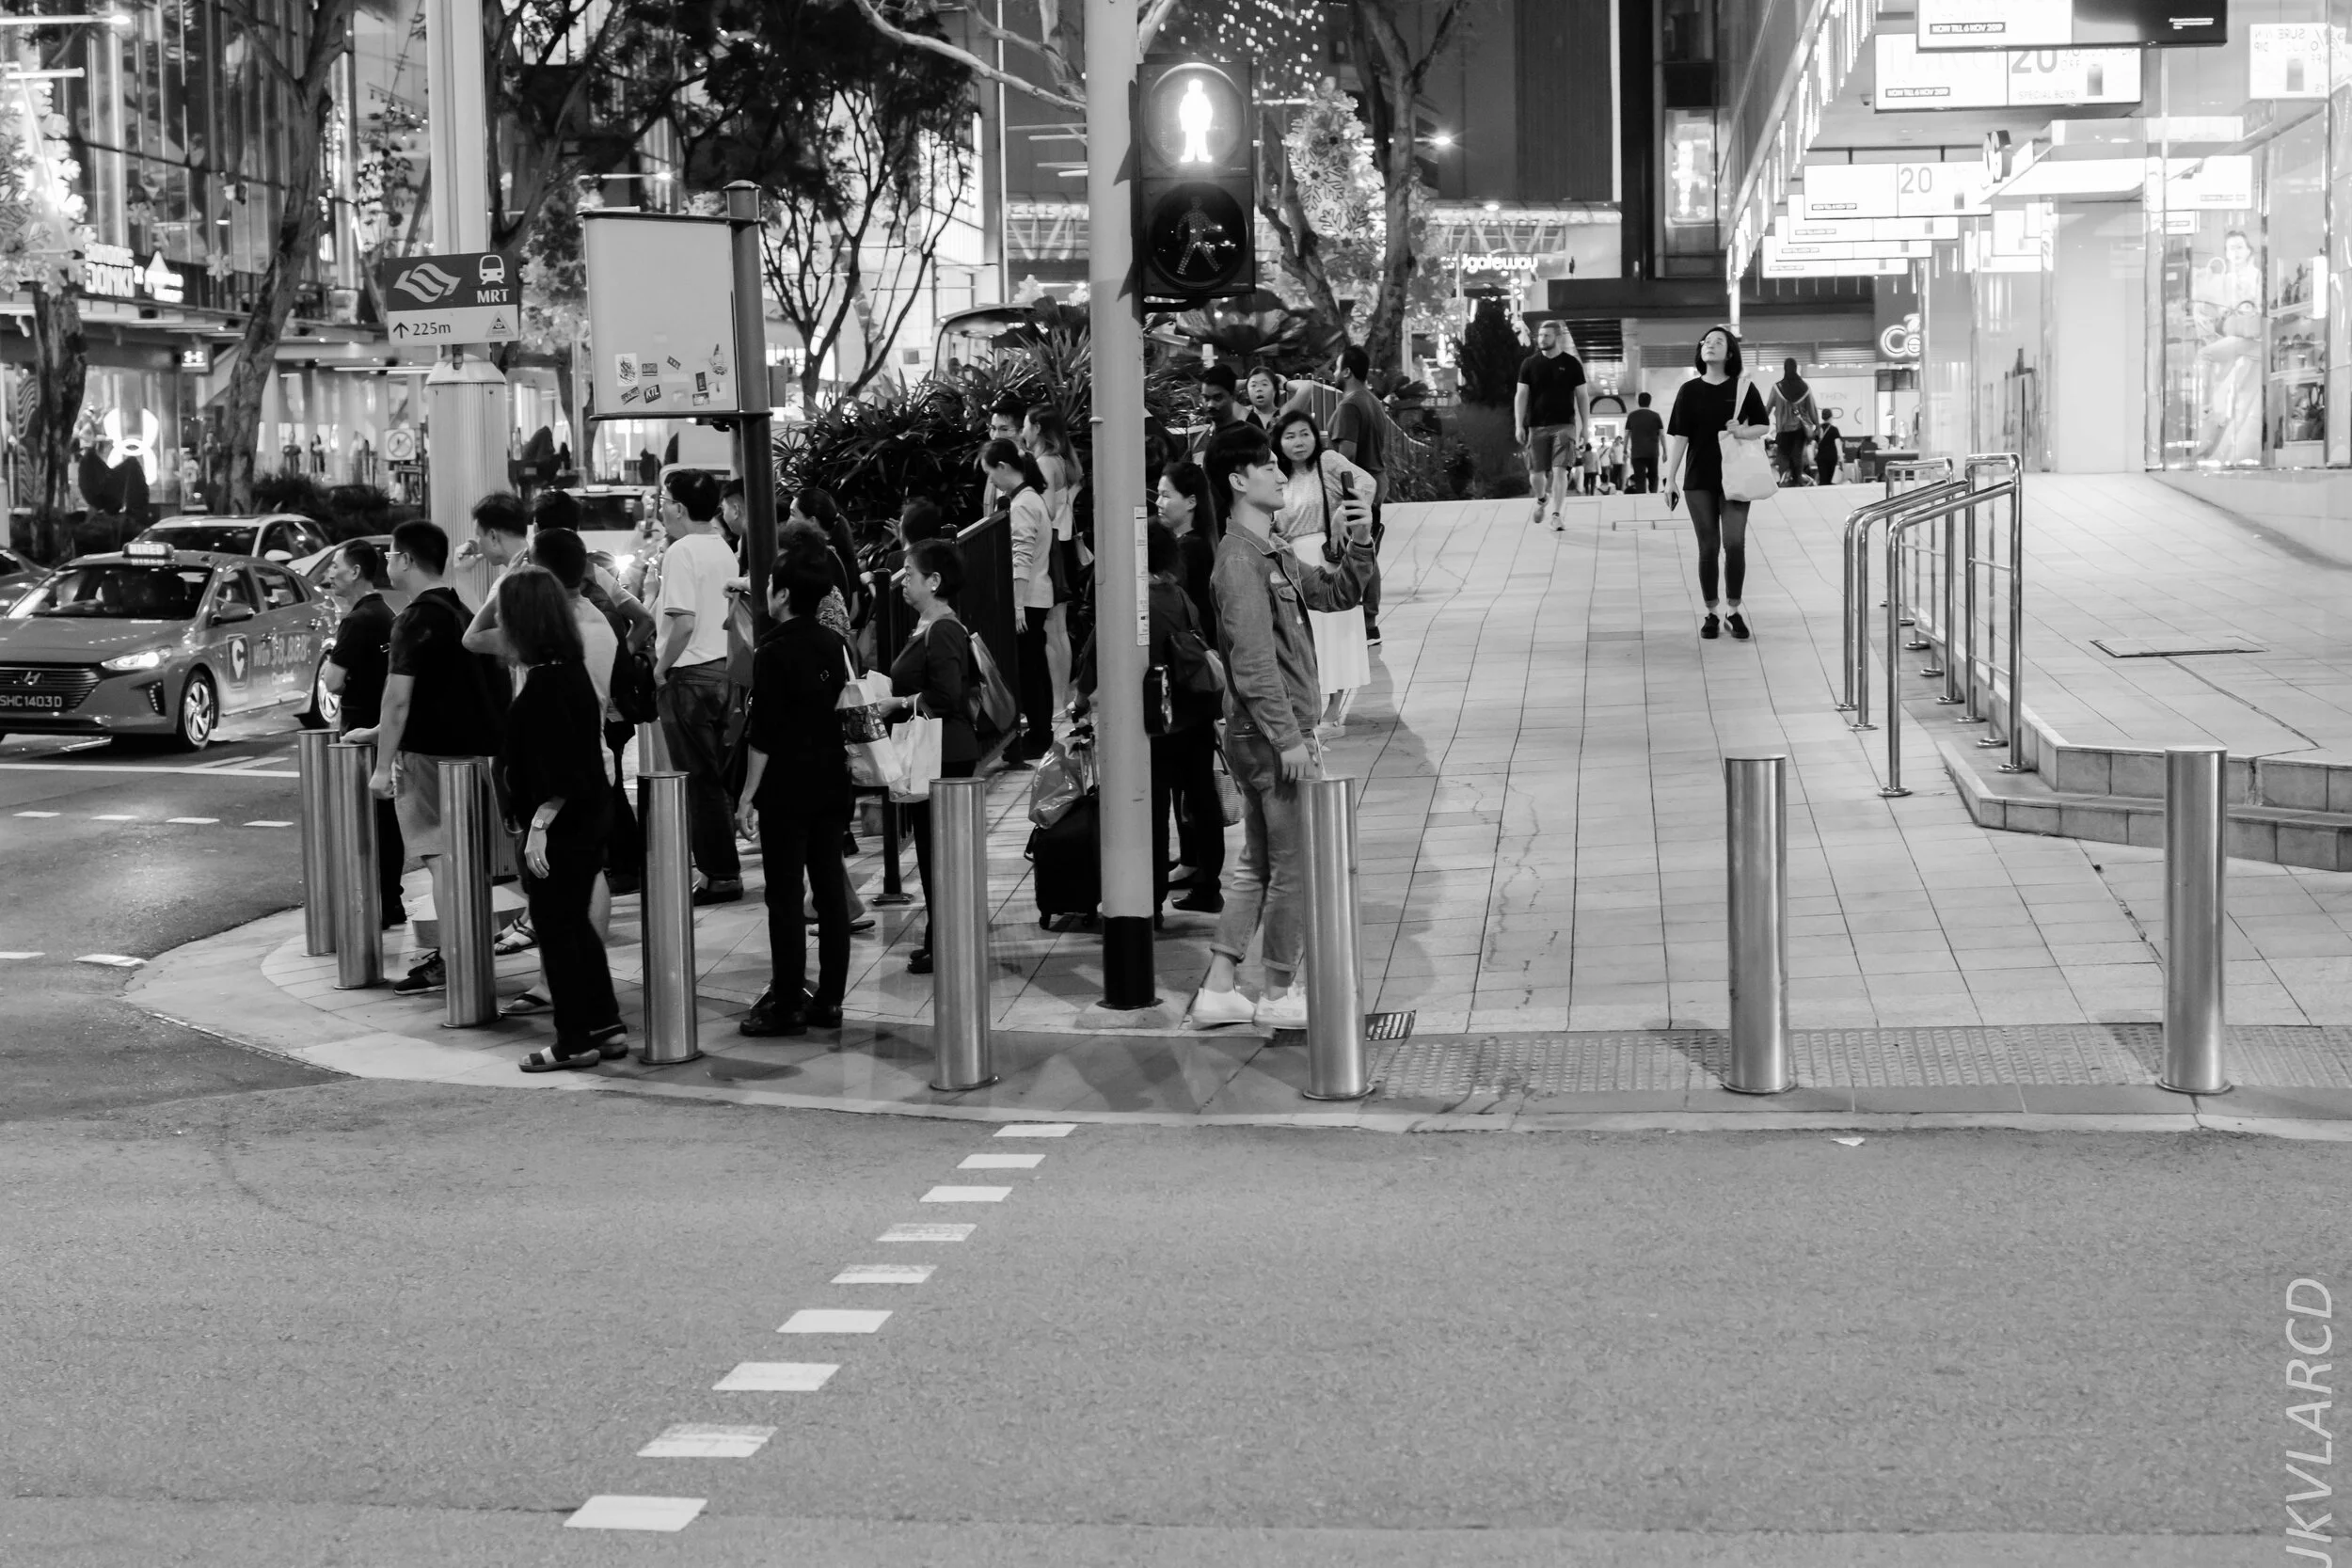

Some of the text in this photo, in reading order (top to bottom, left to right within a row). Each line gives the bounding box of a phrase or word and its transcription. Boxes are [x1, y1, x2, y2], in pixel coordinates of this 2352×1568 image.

[1900, 166, 1932, 194] 20
[477, 289, 509, 304] MRT
[413, 322, 451, 336] 225m
